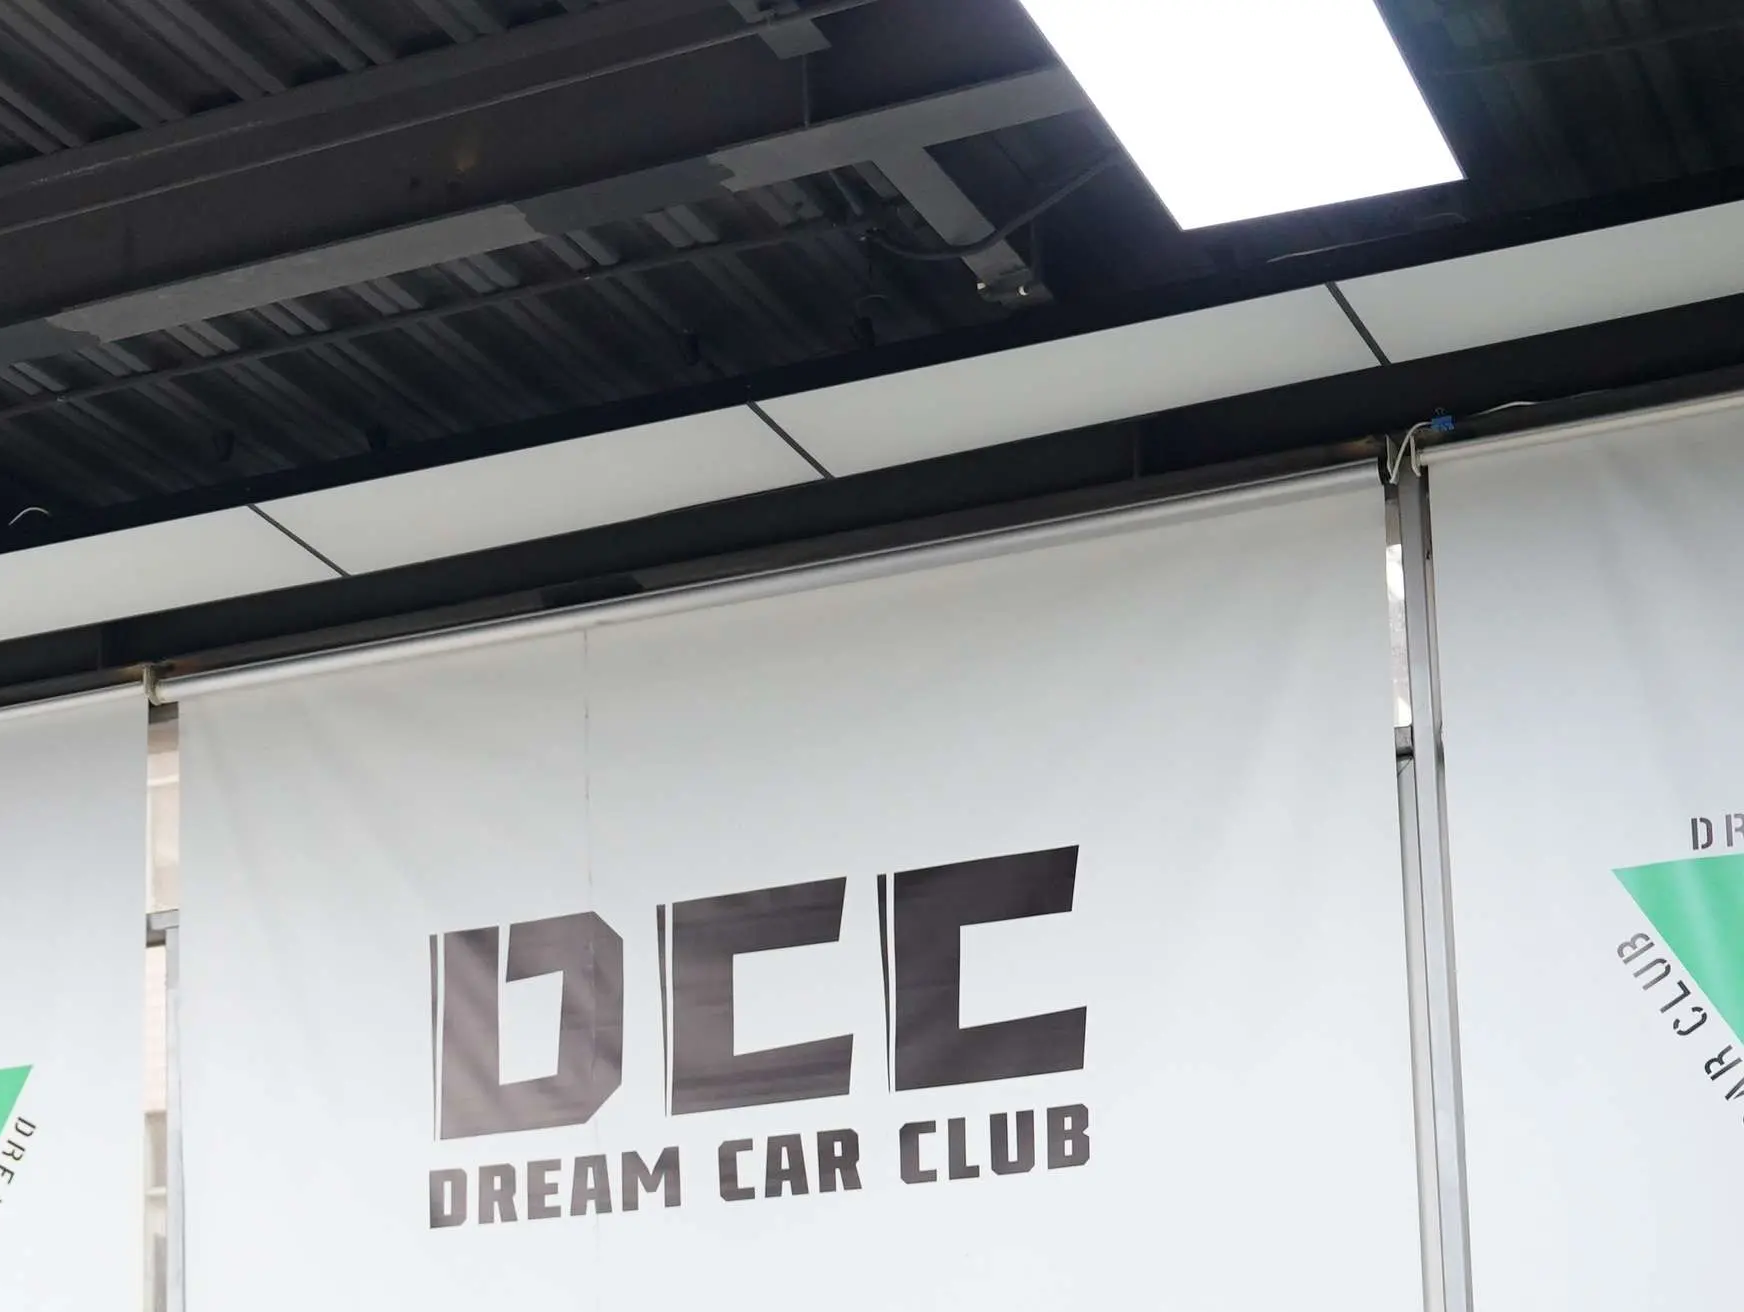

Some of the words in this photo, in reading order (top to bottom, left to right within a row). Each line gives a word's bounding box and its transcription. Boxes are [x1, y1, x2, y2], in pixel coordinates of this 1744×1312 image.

[429, 844, 1088, 1140] DCC
[1617, 933, 1708, 1036] CLUB
[429, 1146, 682, 1229] DREAM
[717, 1128, 863, 1202] CAR
[898, 1103, 1090, 1185] CLUB
